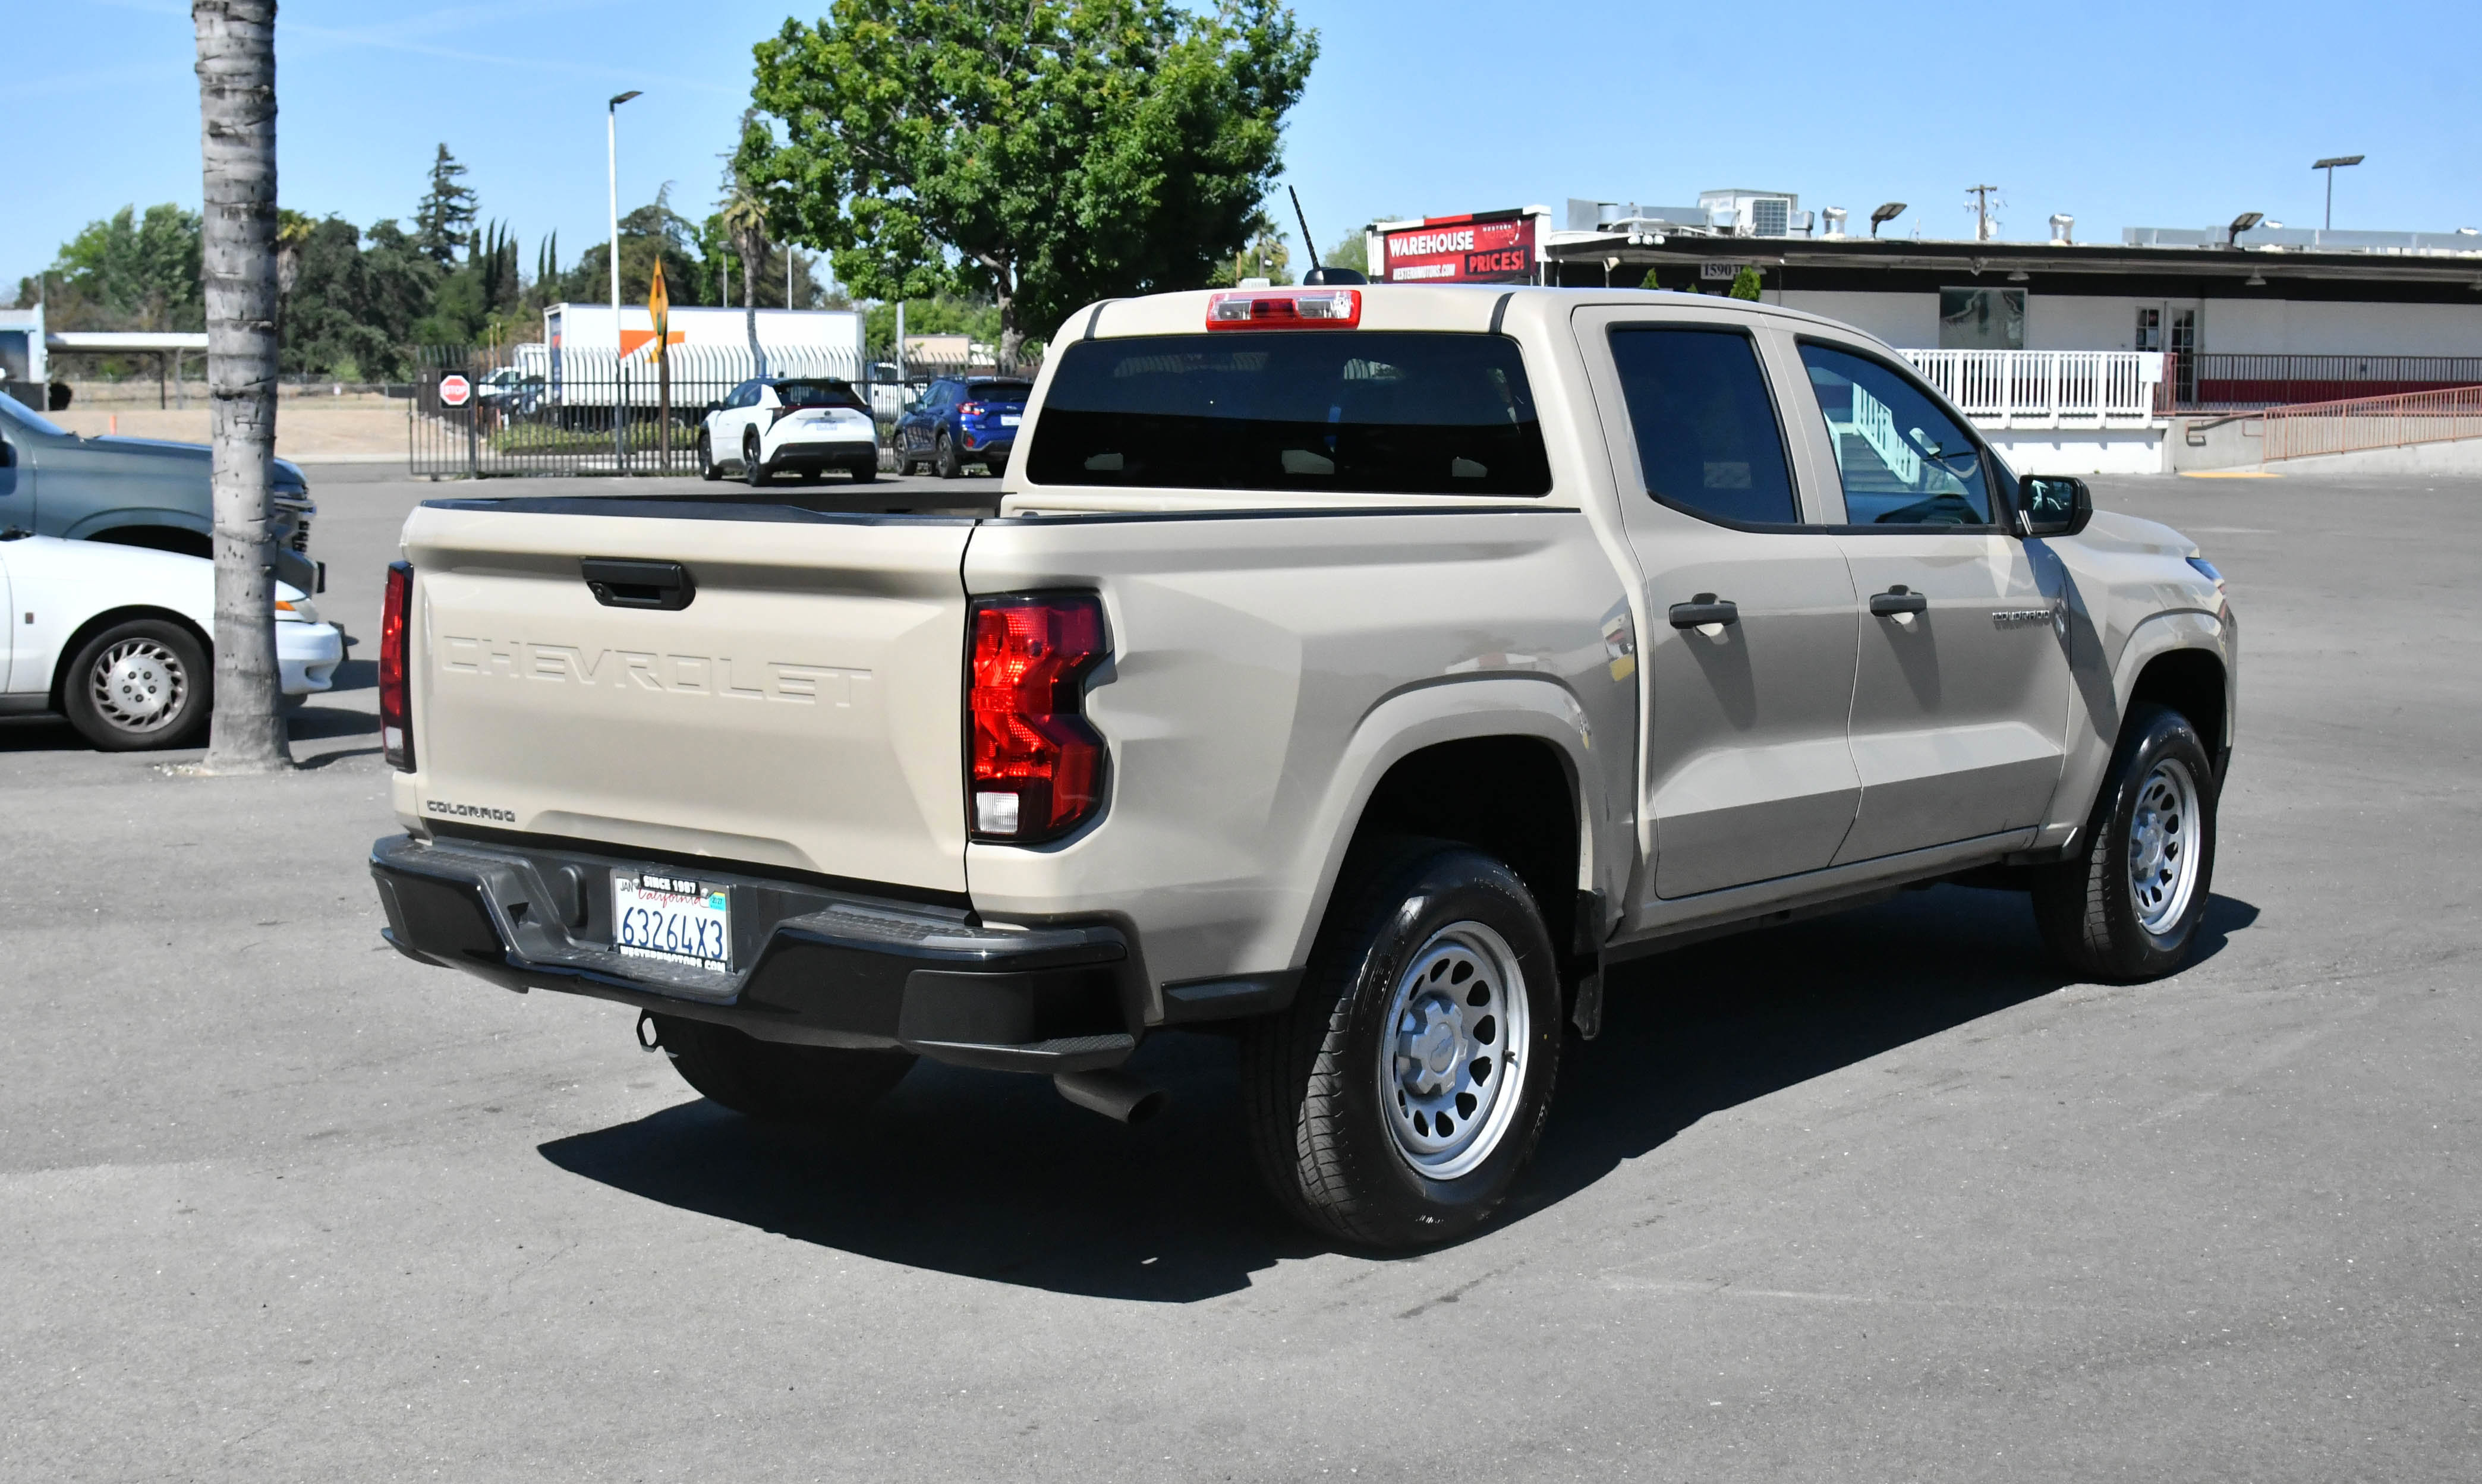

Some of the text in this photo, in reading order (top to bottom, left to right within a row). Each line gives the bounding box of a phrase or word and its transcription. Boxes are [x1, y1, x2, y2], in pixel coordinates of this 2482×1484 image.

[1388, 231, 1474, 257] WAREHOUSE
[1469, 250, 1524, 272] PRICES!
[1705, 264, 1731, 276] 1590
[444, 385, 467, 395] STOP
[442, 635, 873, 708] CHEVROLET
[426, 799, 516, 823] COLORADO
[620, 880, 633, 893] JAN
[643, 875, 696, 894] SINCE 1987
[622, 906, 723, 959] 63264X3
